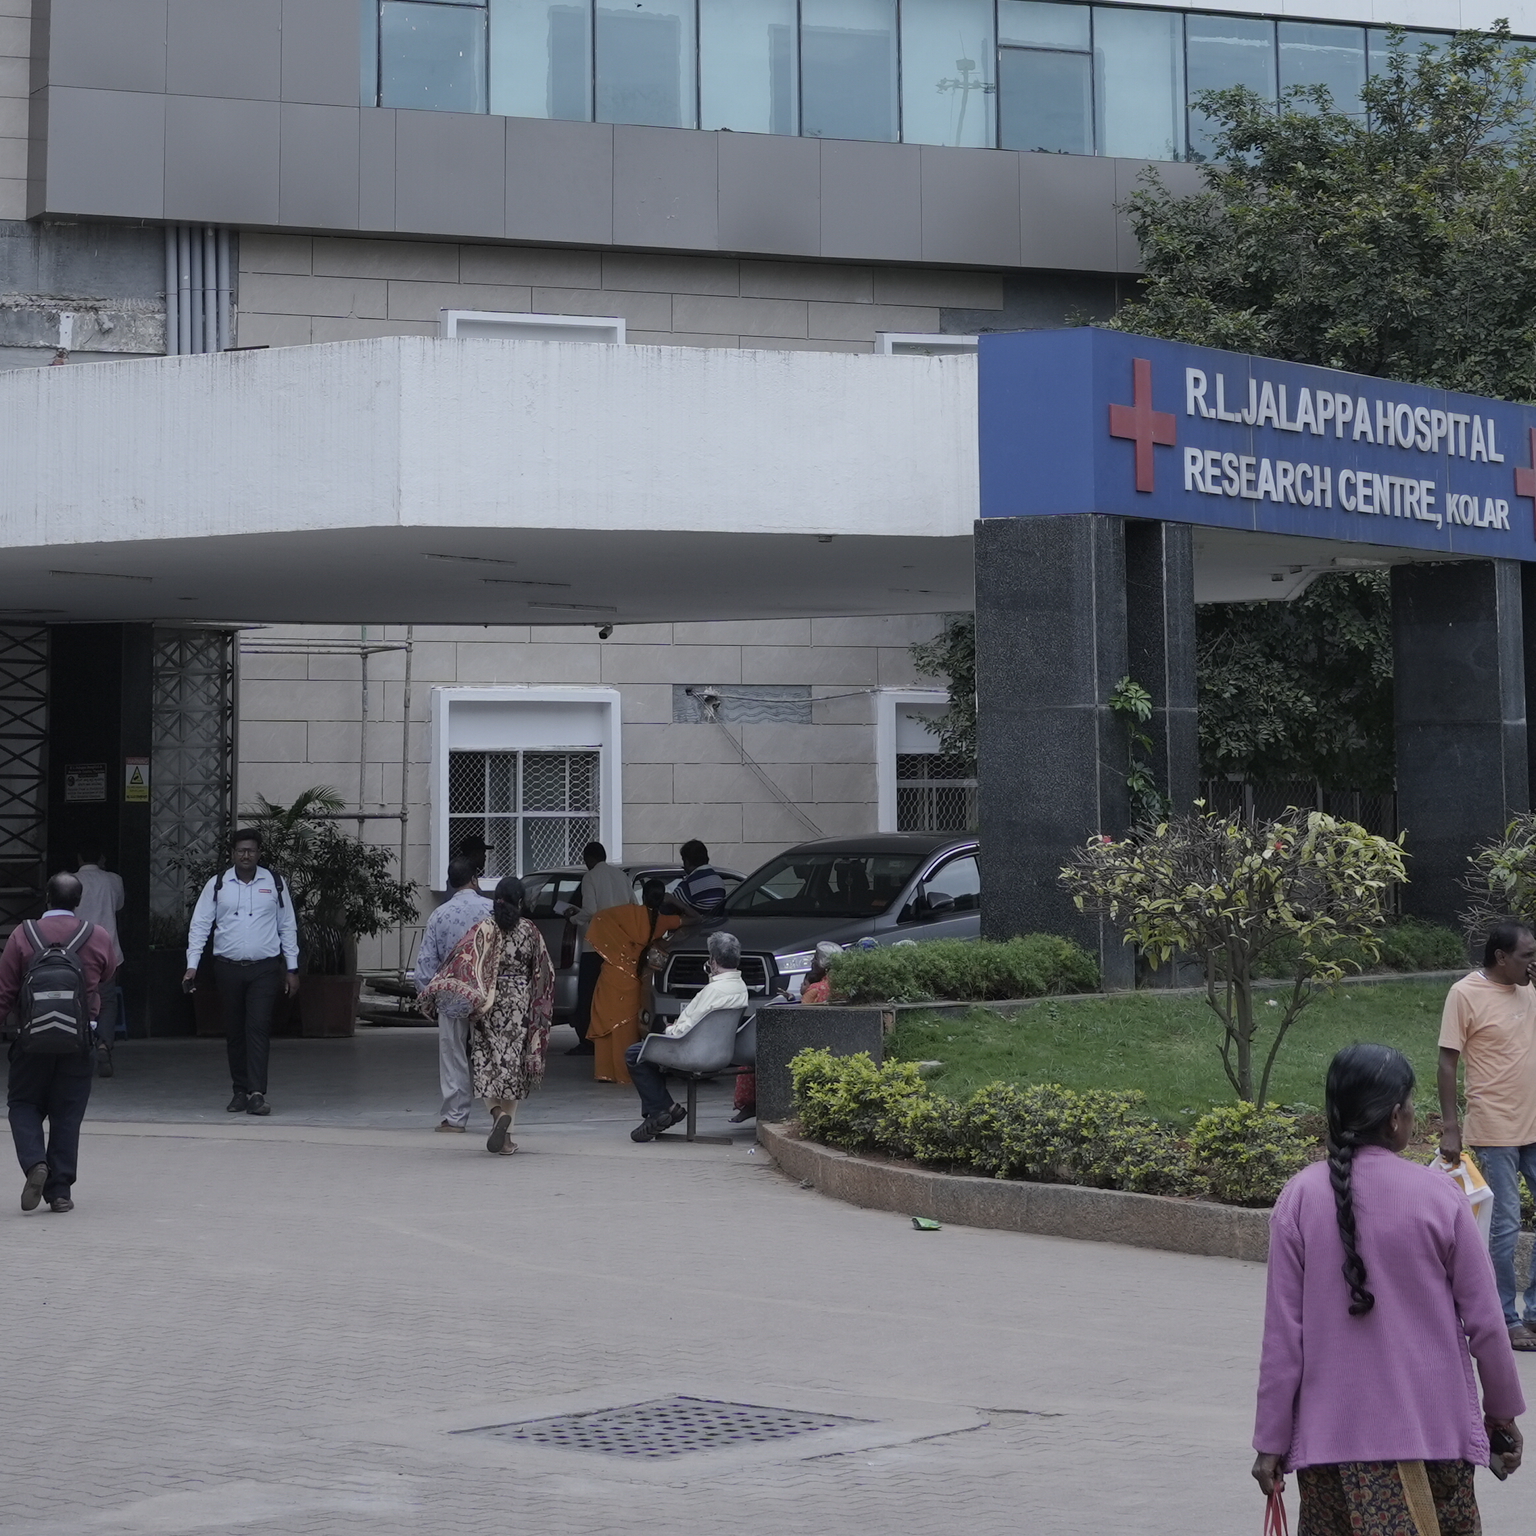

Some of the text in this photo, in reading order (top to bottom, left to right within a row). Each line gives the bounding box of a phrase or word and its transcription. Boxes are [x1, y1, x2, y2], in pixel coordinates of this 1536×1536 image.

[1375, 399, 1505, 463] HOSPITAL
[1184, 447, 1511, 530] RESEARCH CENTRE, KOLAR
